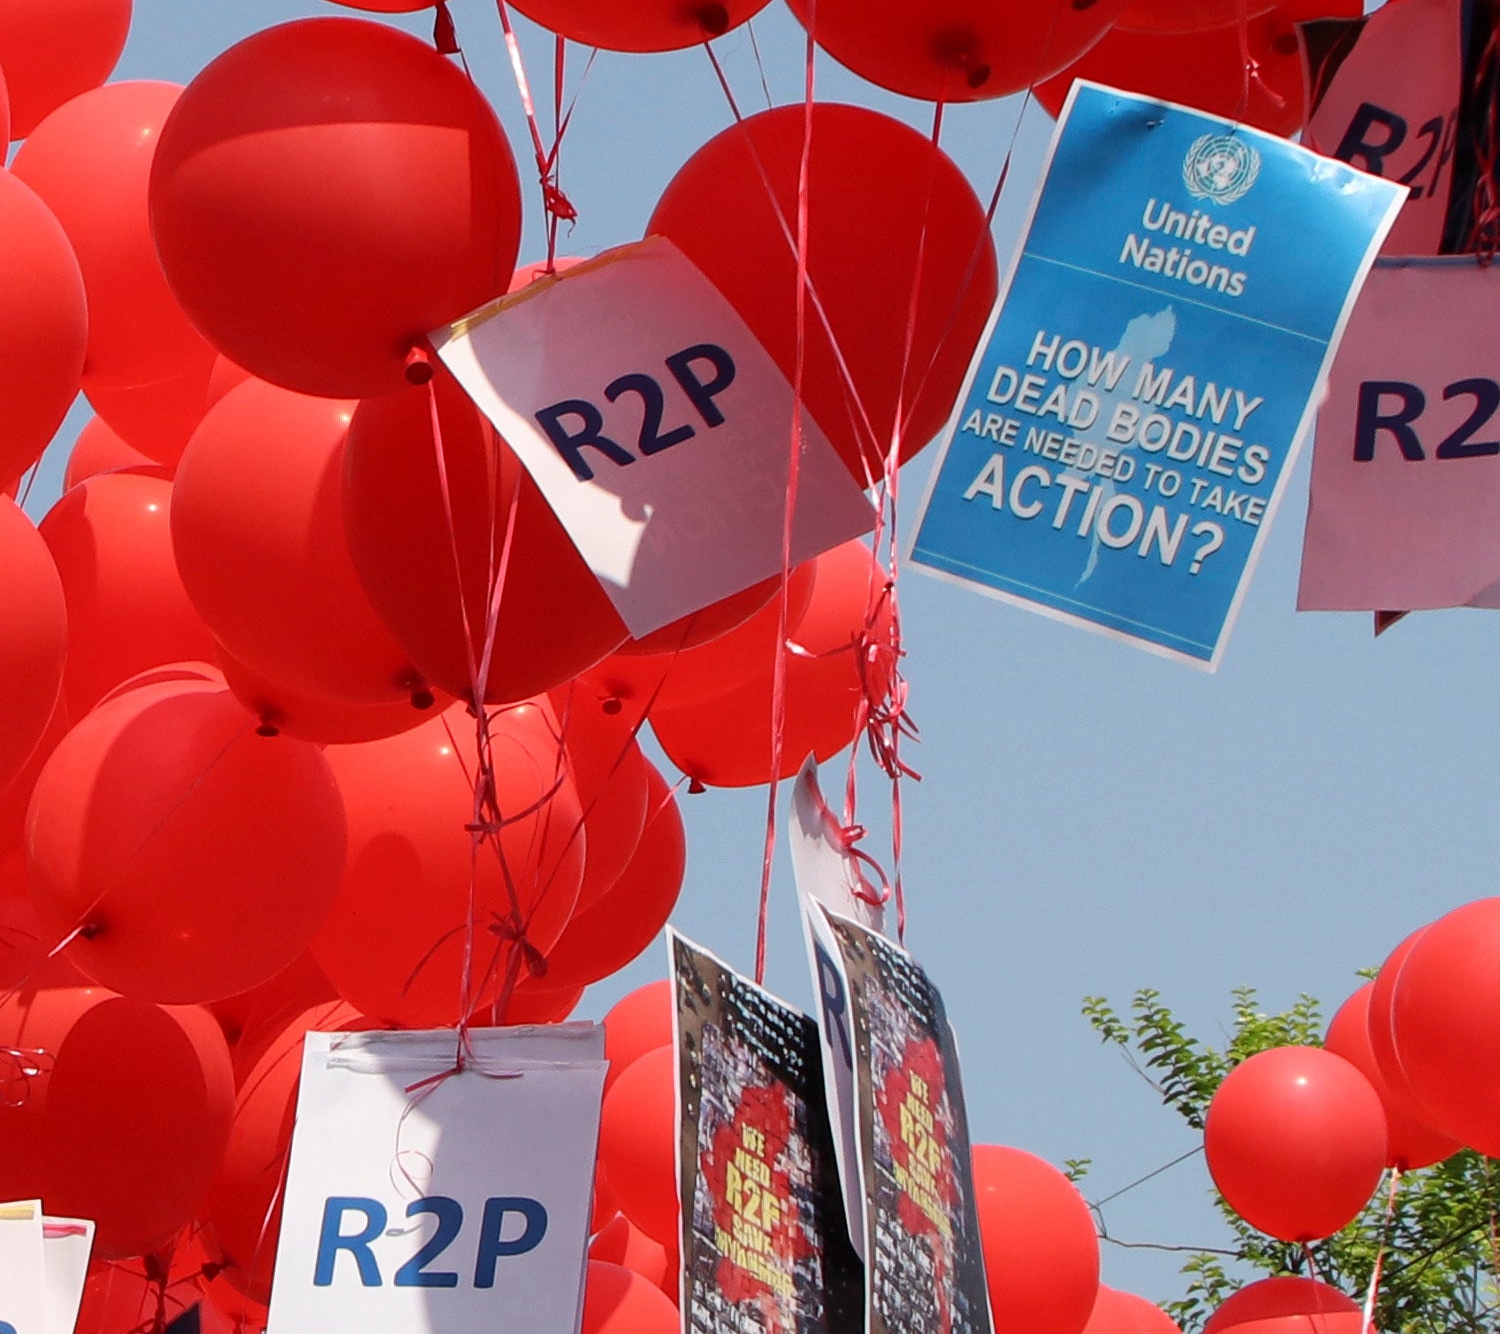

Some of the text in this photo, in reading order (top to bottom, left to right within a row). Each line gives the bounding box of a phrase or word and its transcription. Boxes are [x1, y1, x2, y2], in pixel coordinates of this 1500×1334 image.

[1119, 234, 1247, 298] Nations
[1142, 198, 1256, 257] United
[535, 342, 738, 484] R2P
[987, 367, 1270, 484] DEAD BODIES
[1026, 330, 1263, 432] HOW MANY
[962, 408, 1267, 526] ARE NEEDED TO TAKE
[963, 454, 1225, 576] ACTION?
[735, 1147, 771, 1188] NEED
[742, 1121, 765, 1157] WE
[313, 1195, 548, 1289] R2P
